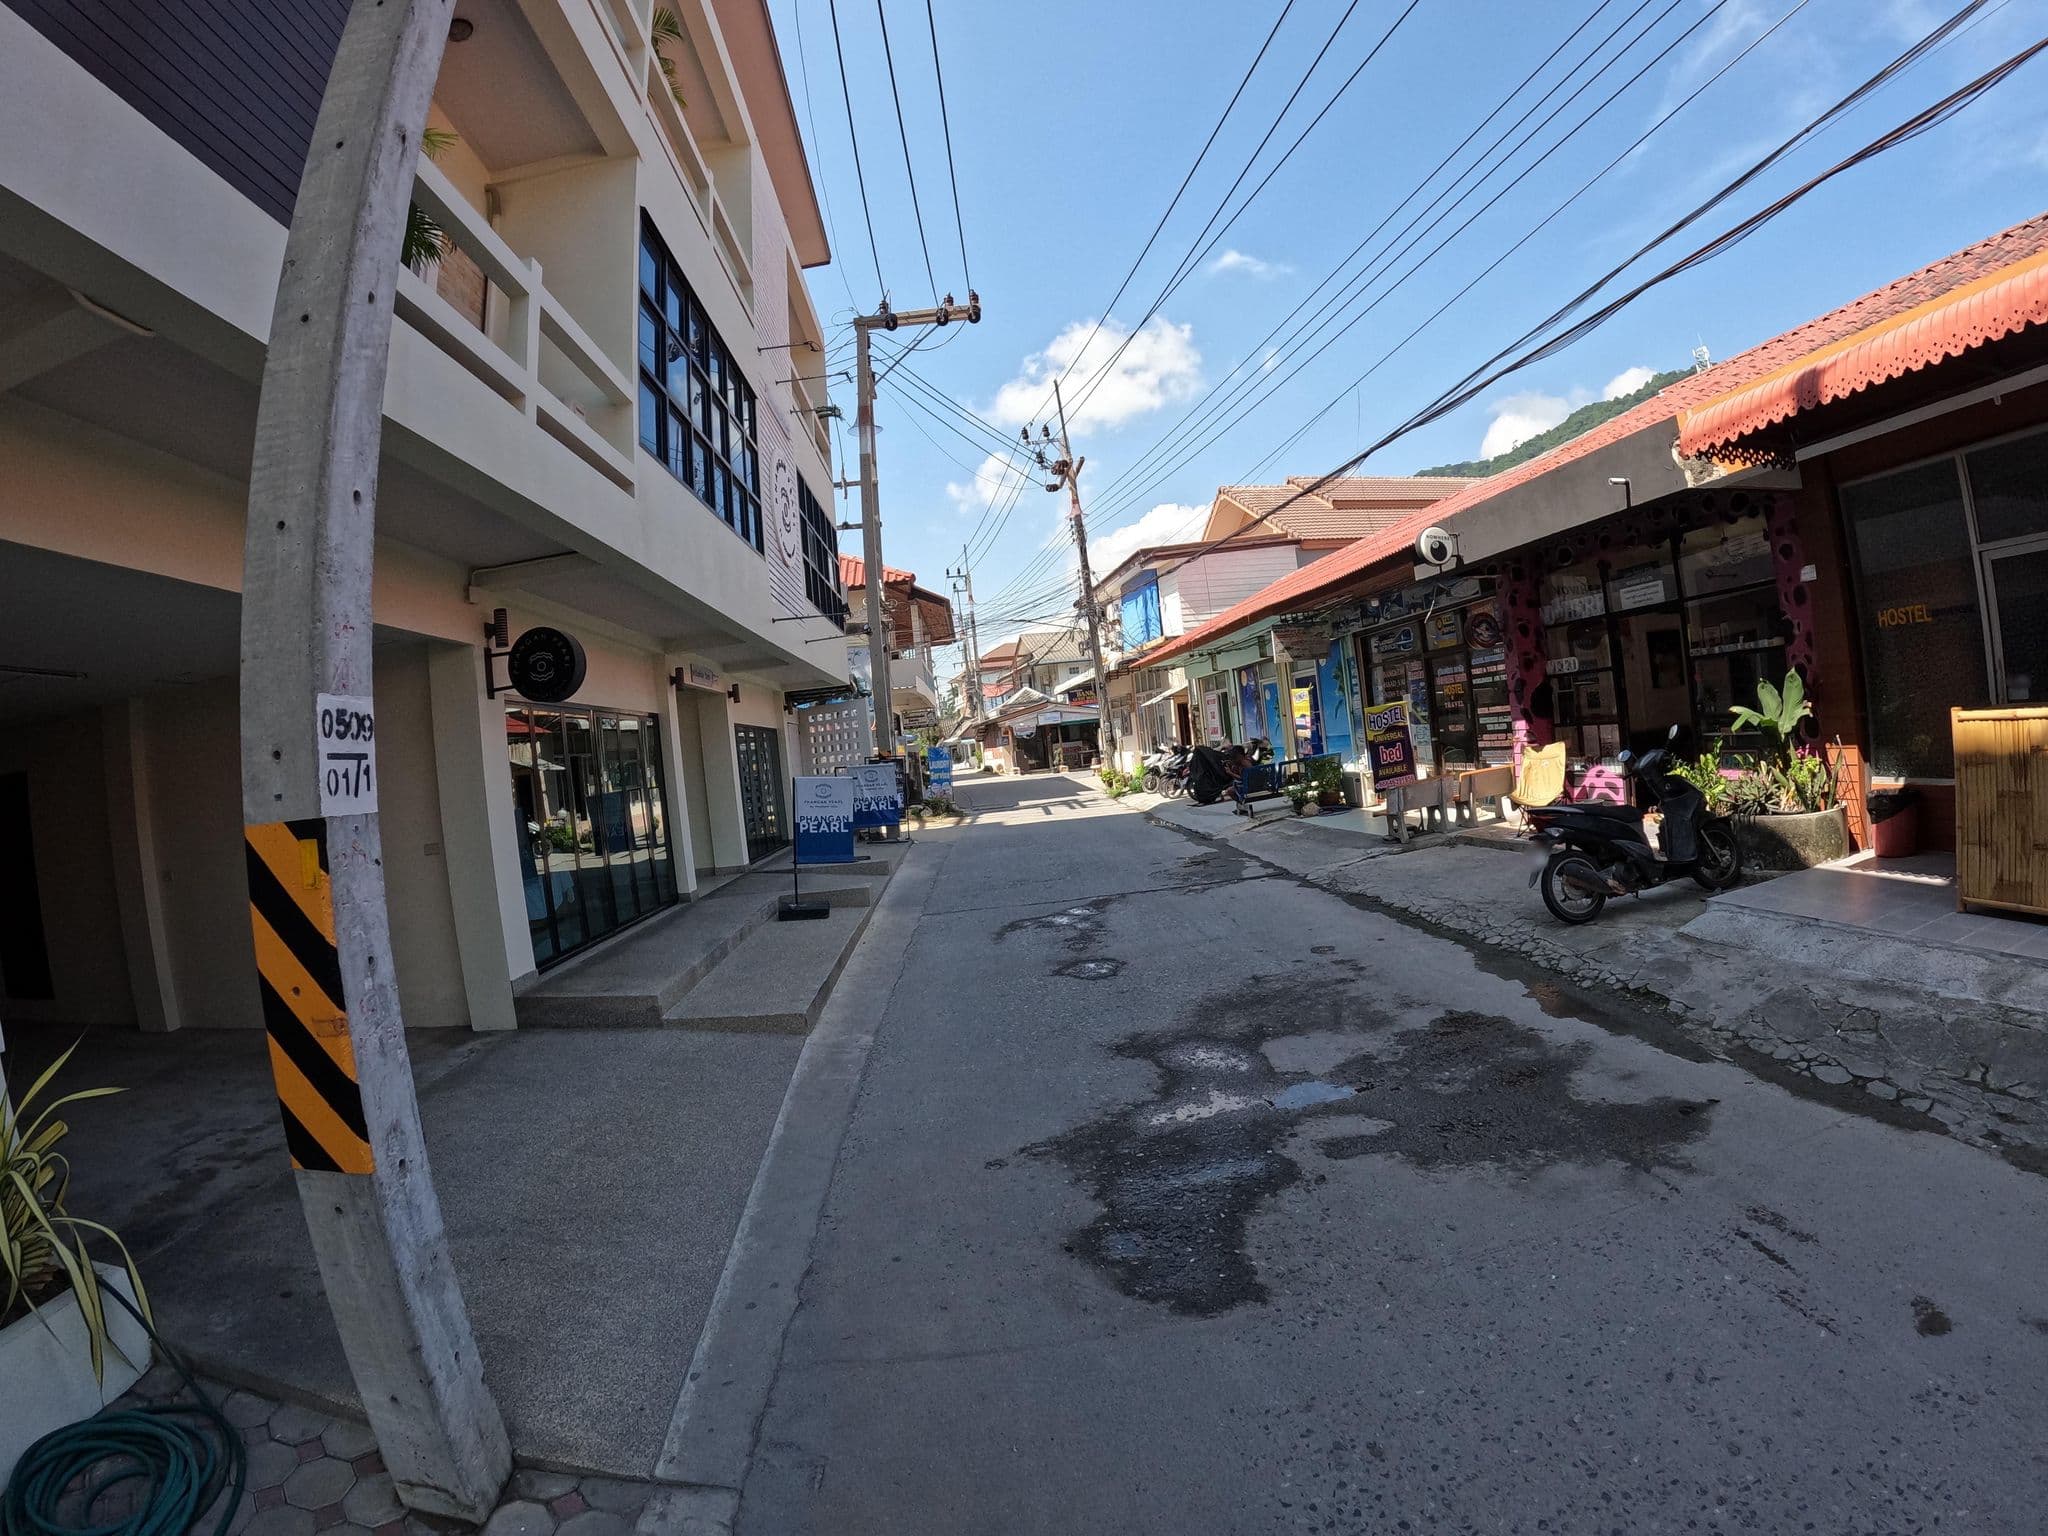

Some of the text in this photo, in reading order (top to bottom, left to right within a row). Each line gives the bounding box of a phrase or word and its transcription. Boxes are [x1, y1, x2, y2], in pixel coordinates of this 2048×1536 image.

[1878, 604, 1933, 628] HOSTEL
[1443, 683, 1464, 696] HOSTEL
[322, 708, 374, 742] 0509
[1368, 706, 1406, 731] HOSTEL
[1375, 732, 1404, 743] UNIVERSAL
[1380, 743, 1404, 764] bed
[1379, 764, 1407, 776] AVAILABLE
[853, 795, 894, 803] PHANGAN
[854, 799, 895, 812] PEARL
[800, 815, 849, 823] PHANGAN
[800, 821, 849, 833] PEARL
